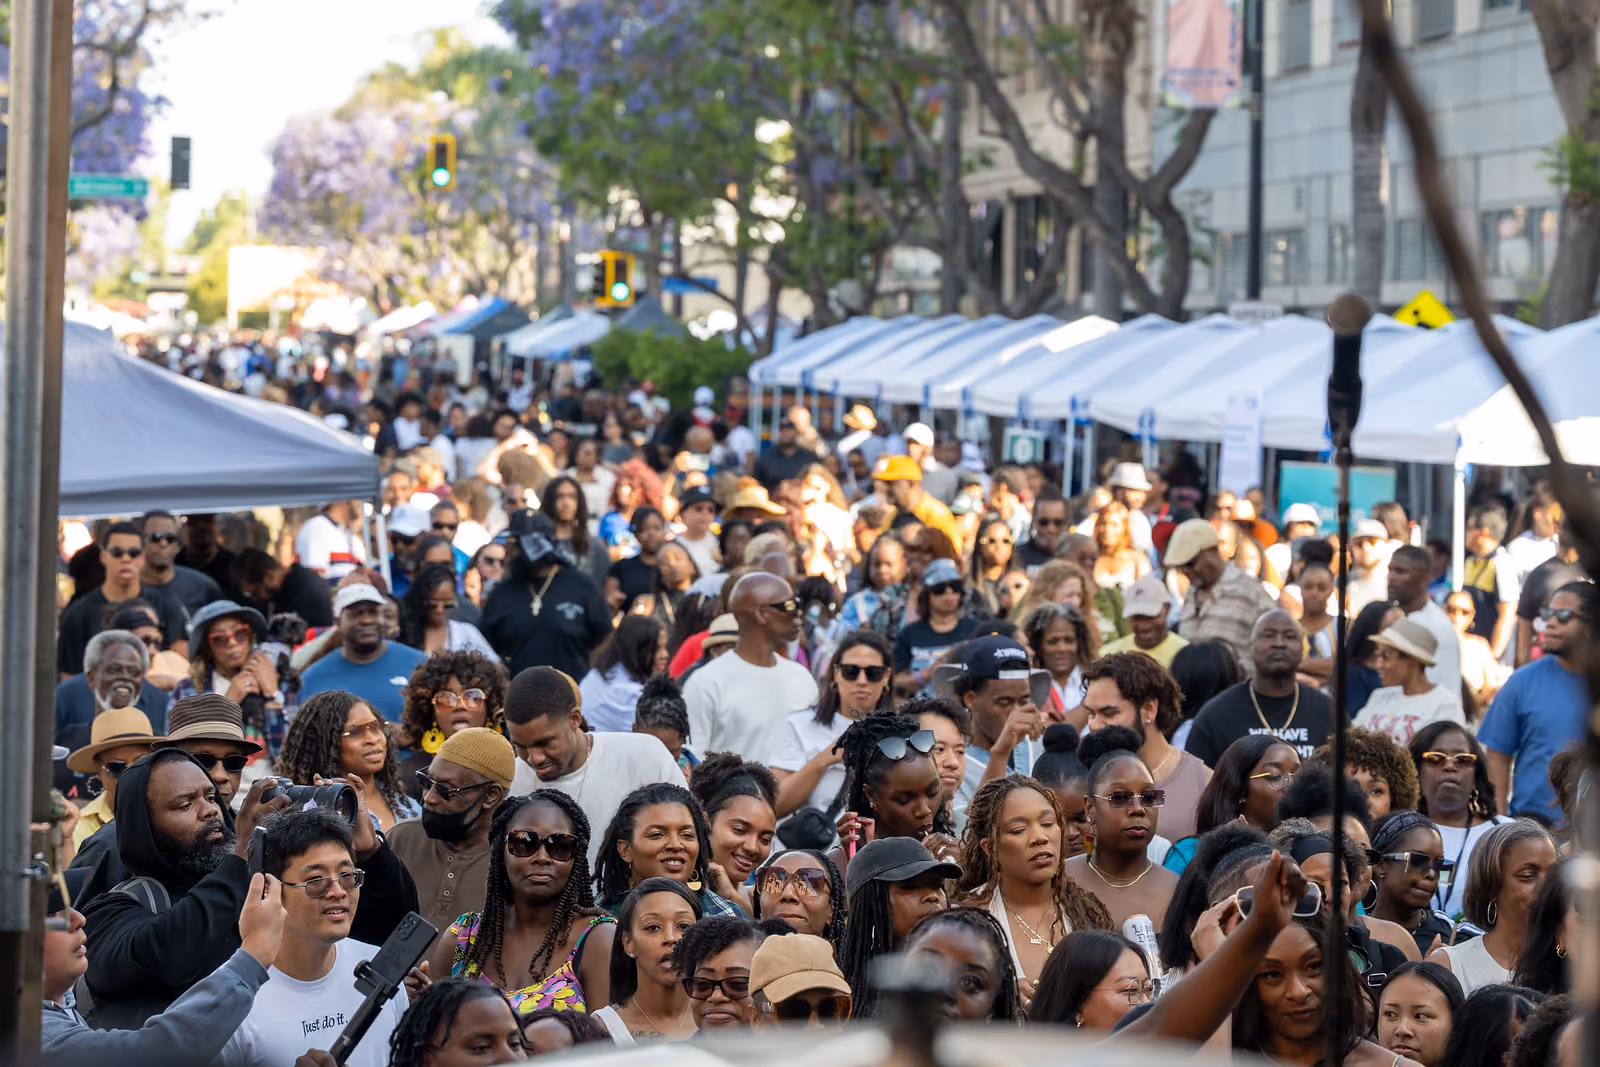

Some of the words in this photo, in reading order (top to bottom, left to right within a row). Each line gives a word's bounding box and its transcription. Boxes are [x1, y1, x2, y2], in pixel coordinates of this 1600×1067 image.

[1272, 728, 1309, 741] HAVE
[301, 1019, 320, 1038] Just
[322, 1015, 335, 1029] do
[336, 1012, 349, 1026] it.
